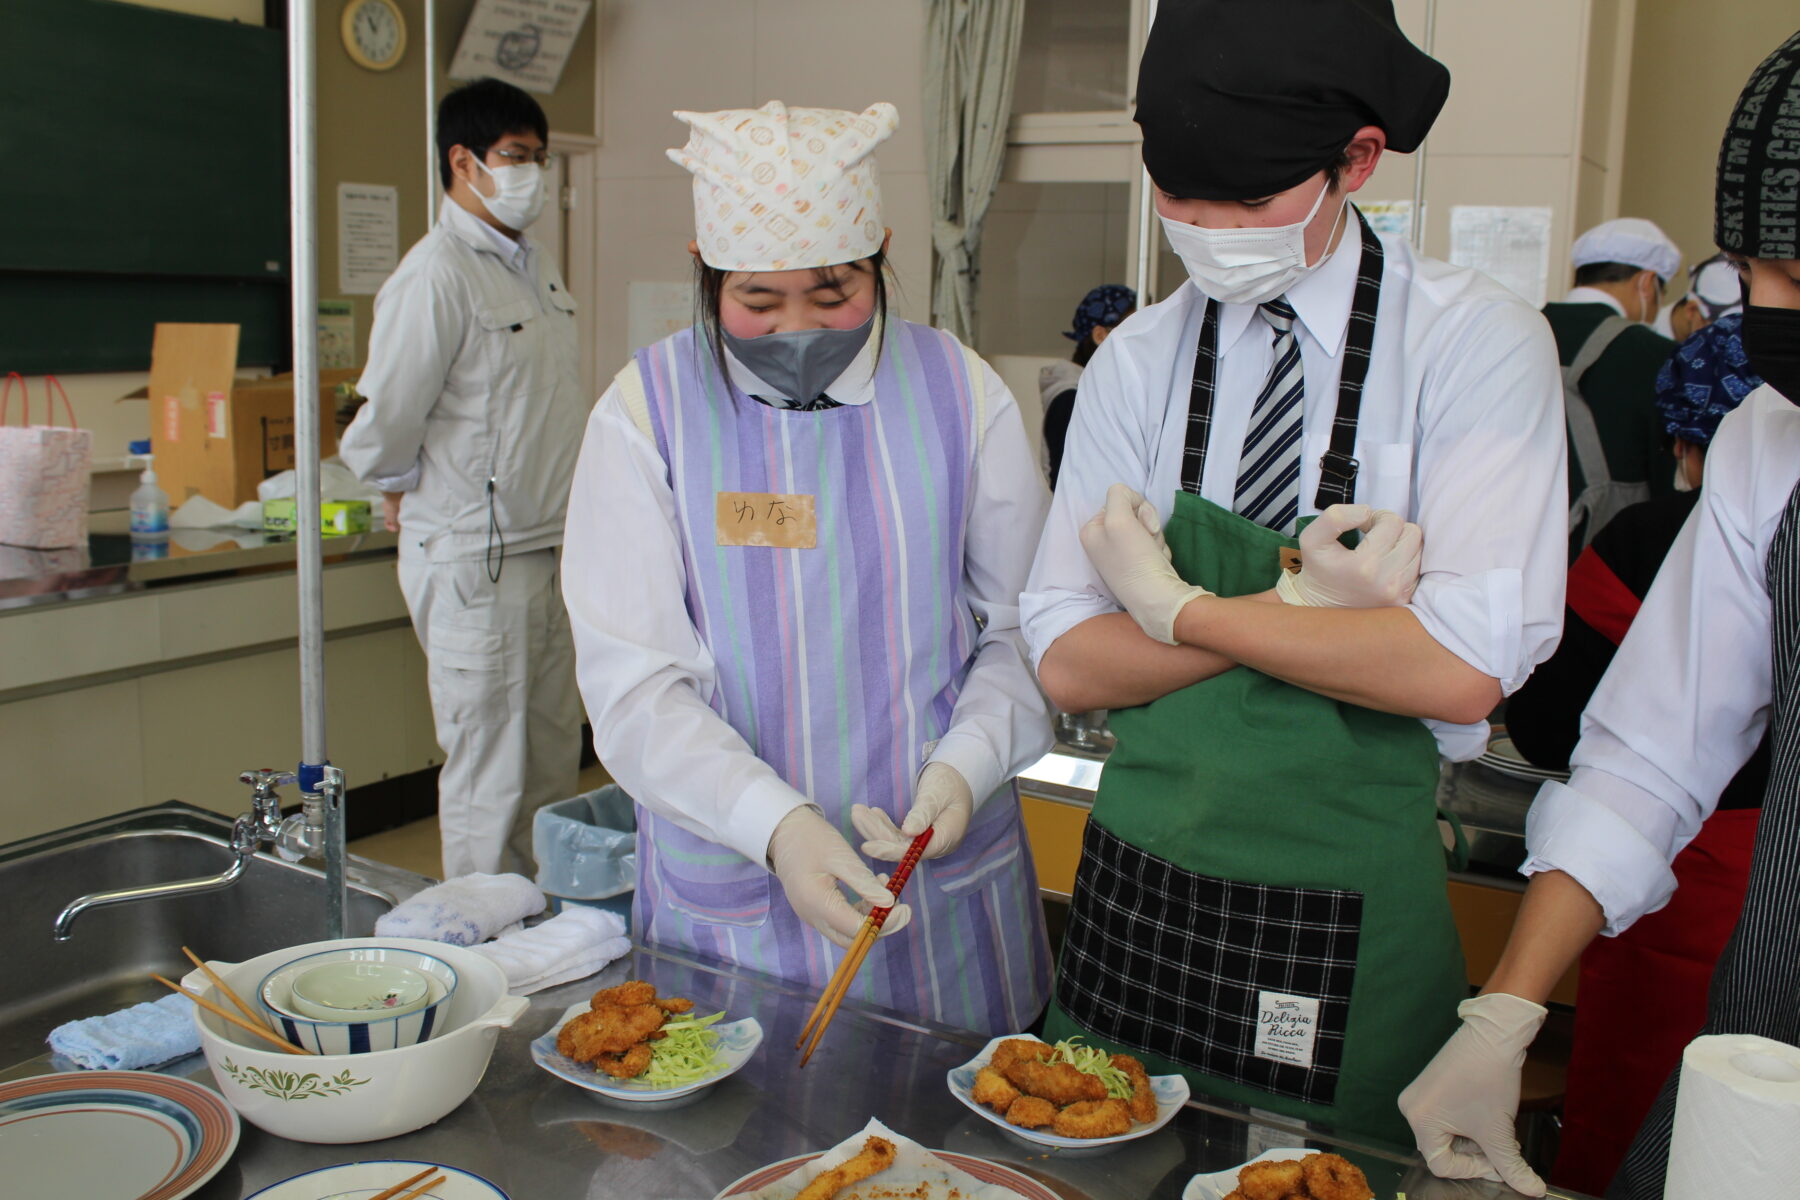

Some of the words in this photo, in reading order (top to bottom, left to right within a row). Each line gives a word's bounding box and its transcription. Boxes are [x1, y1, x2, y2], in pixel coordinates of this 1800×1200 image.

[1736, 57, 1792, 130] EASY
[1724, 137, 1751, 183] I'M
[1758, 167, 1800, 259] DEFIES
[1260, 1010, 1312, 1028] Delizia
[1267, 1024, 1306, 1037] Ricca
